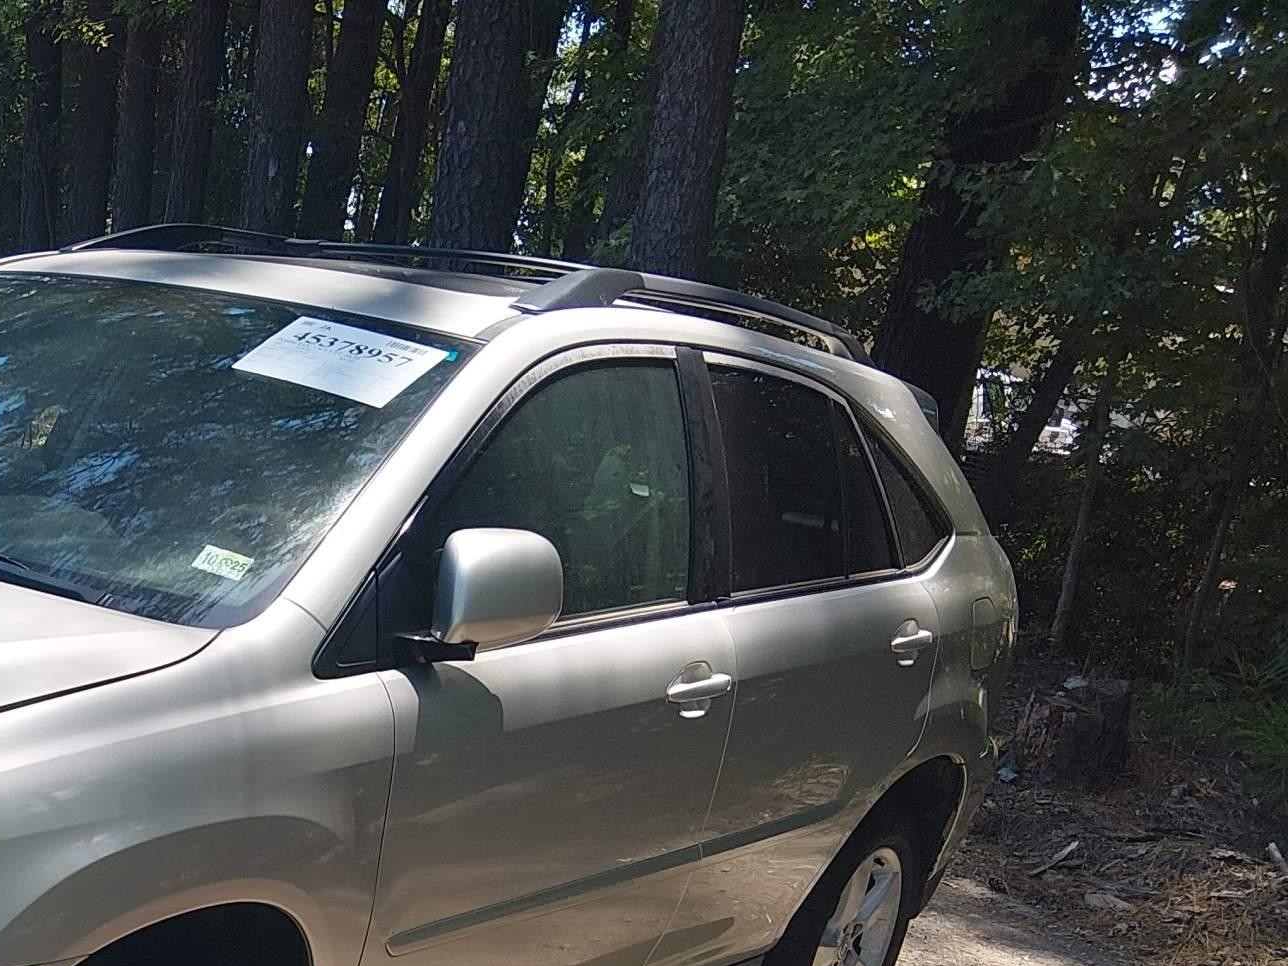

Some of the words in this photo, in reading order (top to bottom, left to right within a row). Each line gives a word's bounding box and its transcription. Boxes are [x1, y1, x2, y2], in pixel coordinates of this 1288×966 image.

[293, 331, 414, 367] 45378957
[202, 551, 219, 566] 10
[230, 560, 248, 573] 25
